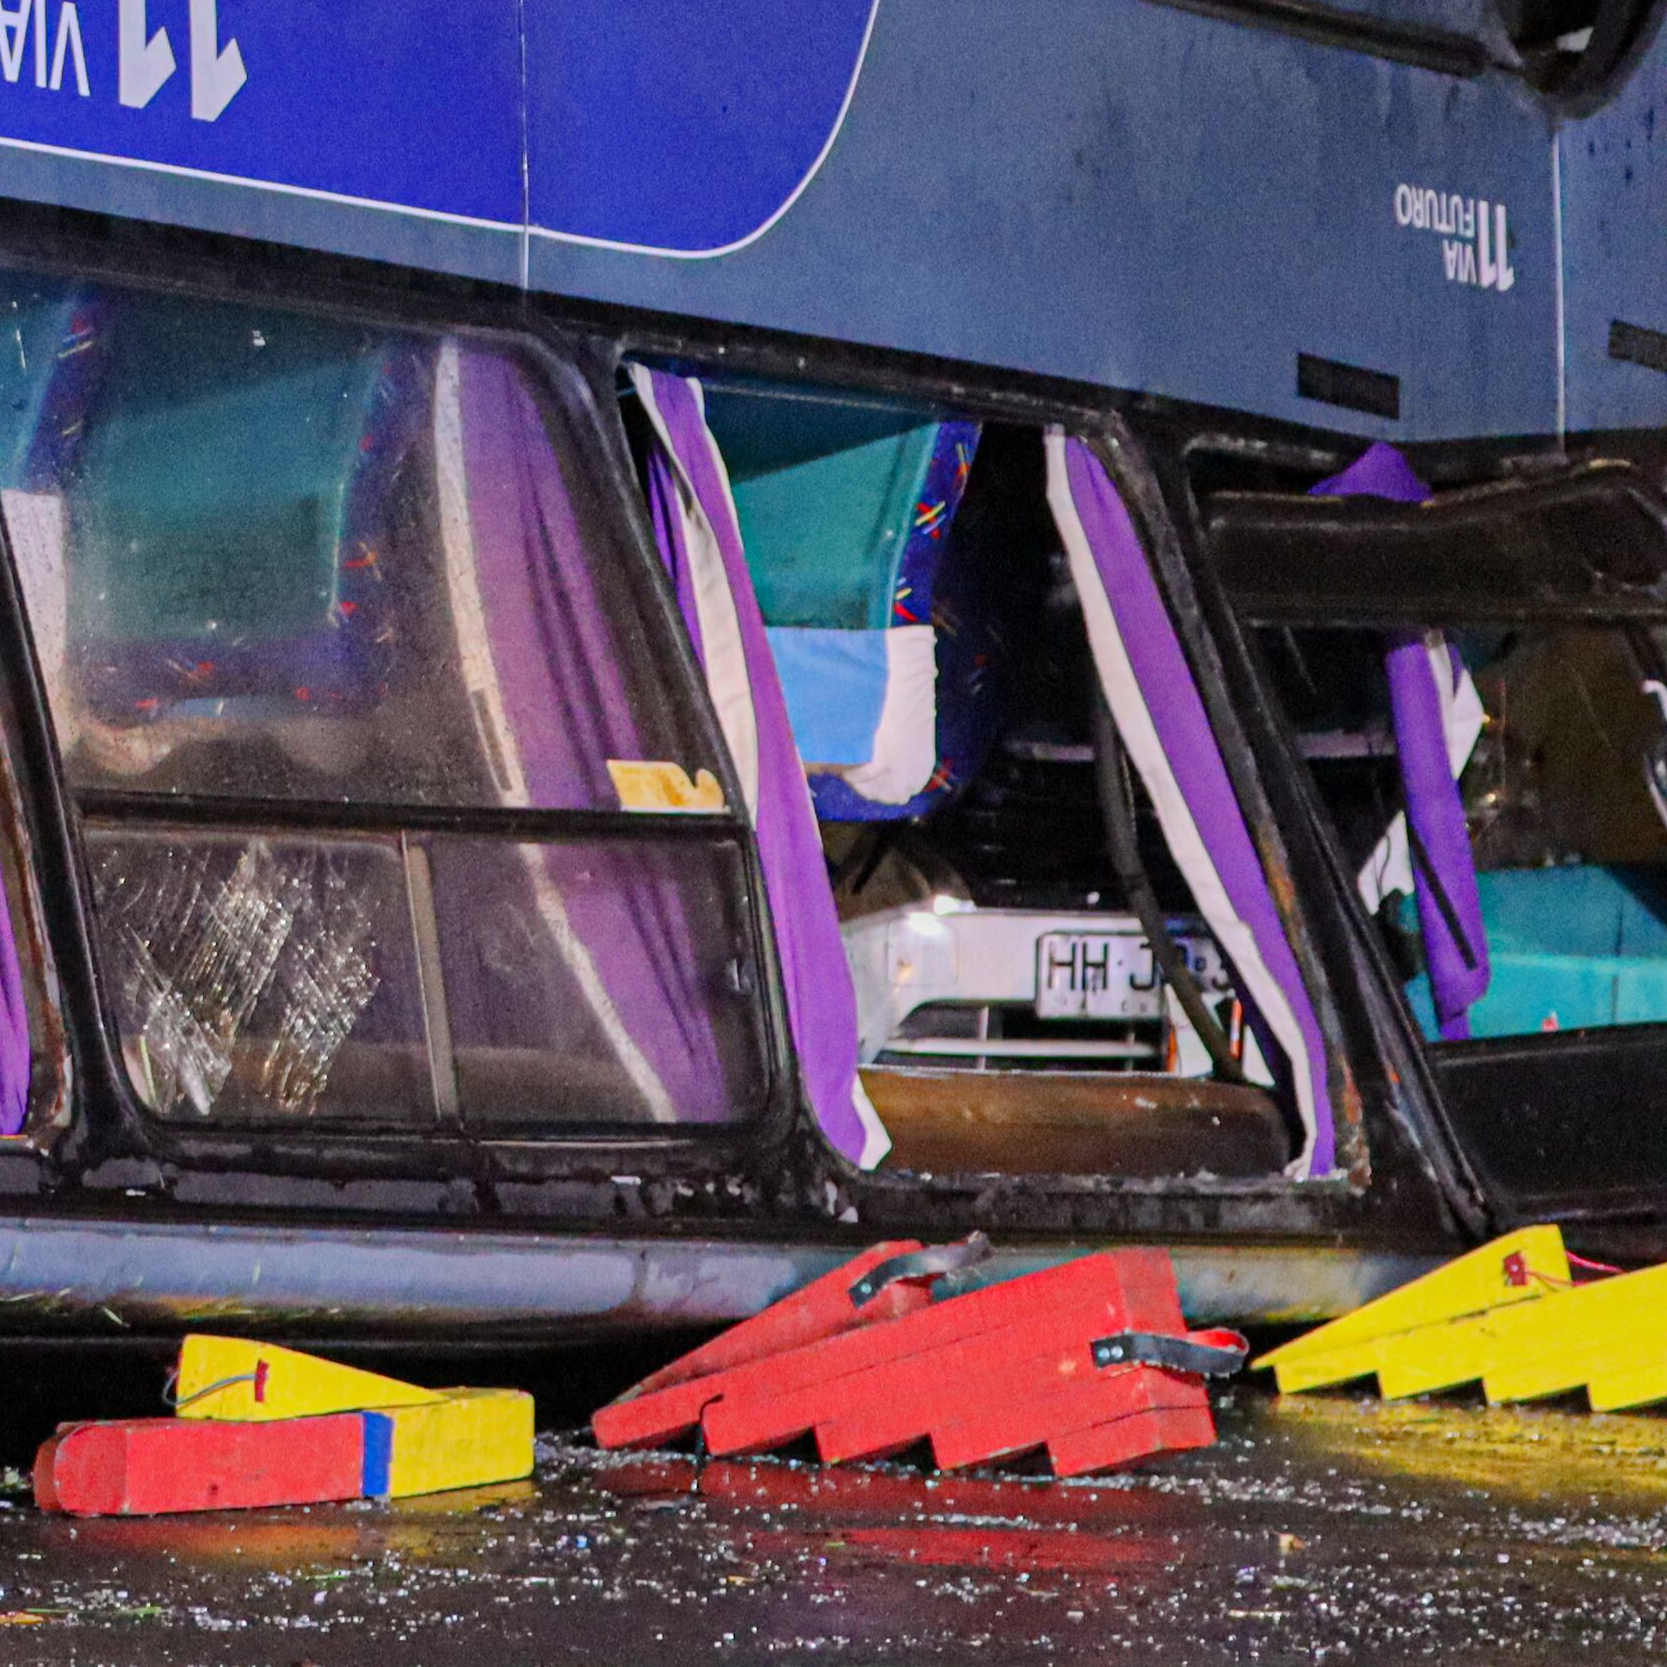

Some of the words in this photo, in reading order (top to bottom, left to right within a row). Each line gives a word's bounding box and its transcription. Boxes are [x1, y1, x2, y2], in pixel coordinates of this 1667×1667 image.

[1394, 182, 1476, 240] FUTURO
[1442, 238, 1477, 284] VIA
[1477, 199, 1515, 292] 11
